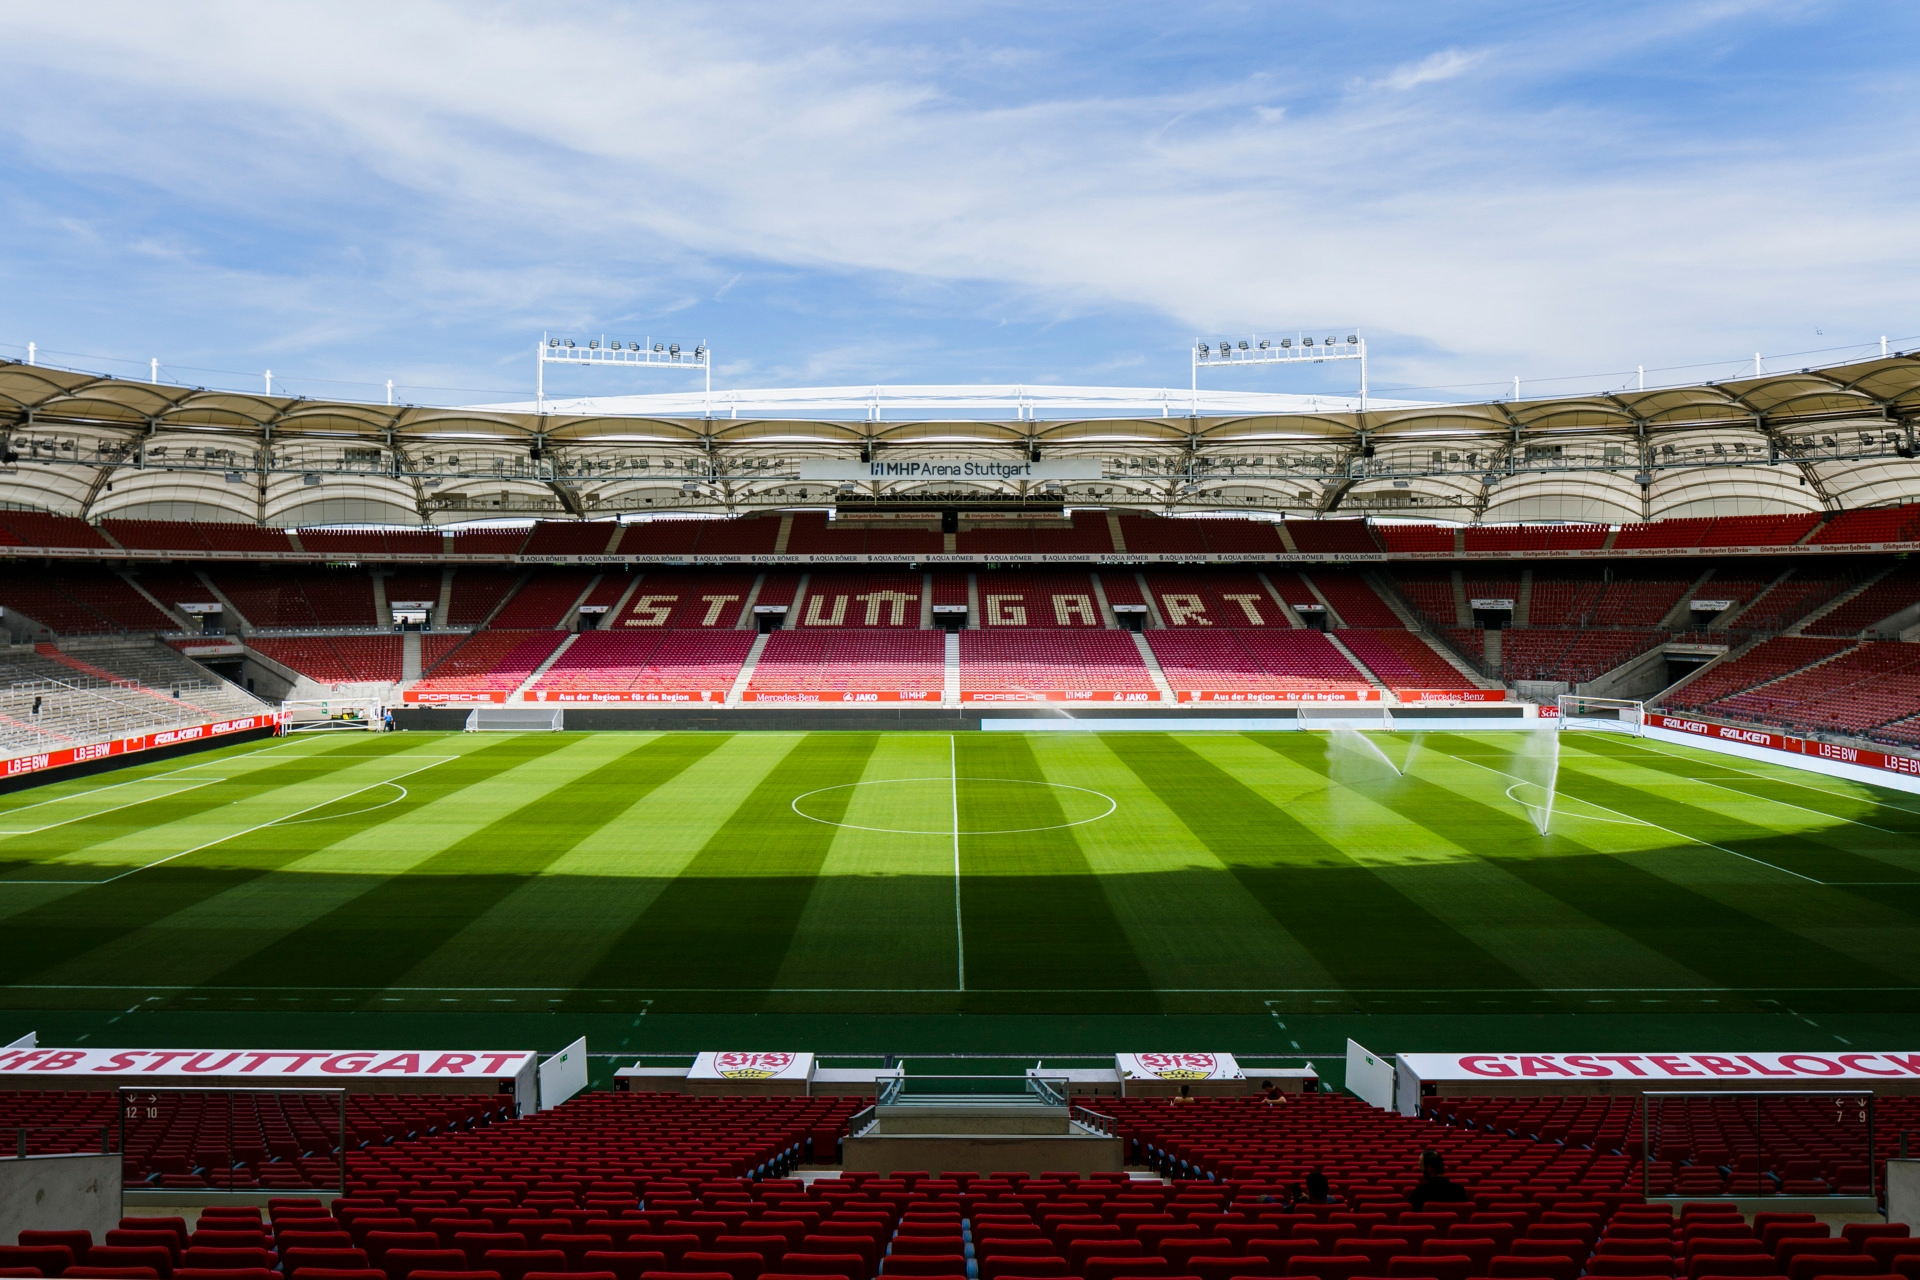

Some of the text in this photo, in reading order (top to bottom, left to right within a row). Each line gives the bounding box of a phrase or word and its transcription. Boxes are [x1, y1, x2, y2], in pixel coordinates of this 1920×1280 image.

[887, 462, 1031, 479] MHP Arena Stuttgart
[593, 694, 622, 702] Region
[660, 694, 689, 702] Region
[756, 694, 819, 702] Mercedes-Benz
[1247, 693, 1275, 701] Region
[1316, 693, 1345, 701] Region
[1421, 692, 1484, 701] Mercedes-Benz
[211, 718, 254, 734] FALKEN
[1662, 717, 1708, 734] FALKEN
[154, 727, 203, 745] FALKEN
[1719, 727, 1770, 745] FALKEN
[91, 1051, 527, 1074] STUTTGART
[1458, 1054, 1920, 1077] GÄSTEBLOCK
[126, 1107, 157, 1118] 12 10
[1836, 1111, 1866, 1122] 7 9
